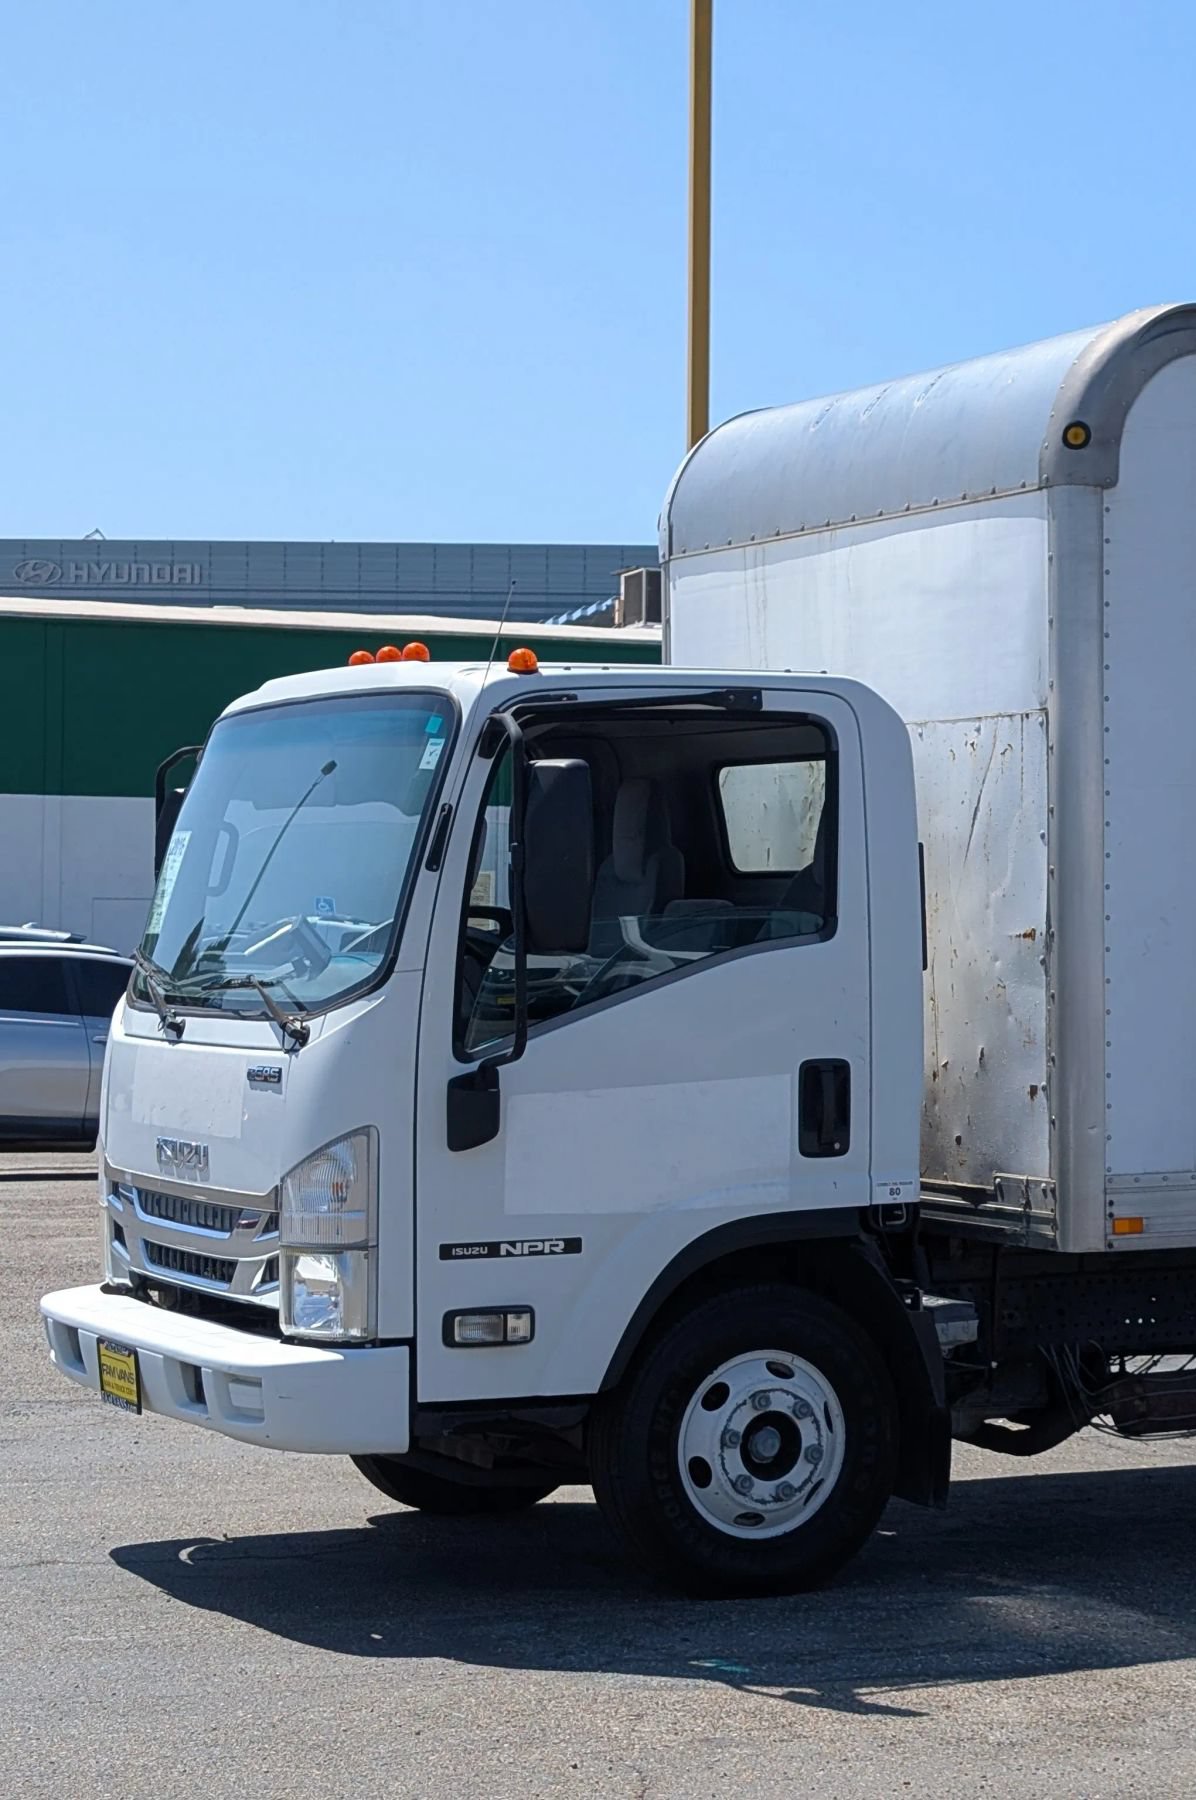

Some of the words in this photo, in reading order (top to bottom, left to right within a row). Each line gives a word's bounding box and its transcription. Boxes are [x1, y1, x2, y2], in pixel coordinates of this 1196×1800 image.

[69, 562, 203, 585] HYUNDAI
[156, 1135, 210, 1173] ISUZU
[451, 1246, 488, 1256] ISUZU
[500, 1240, 565, 1256] NPR
